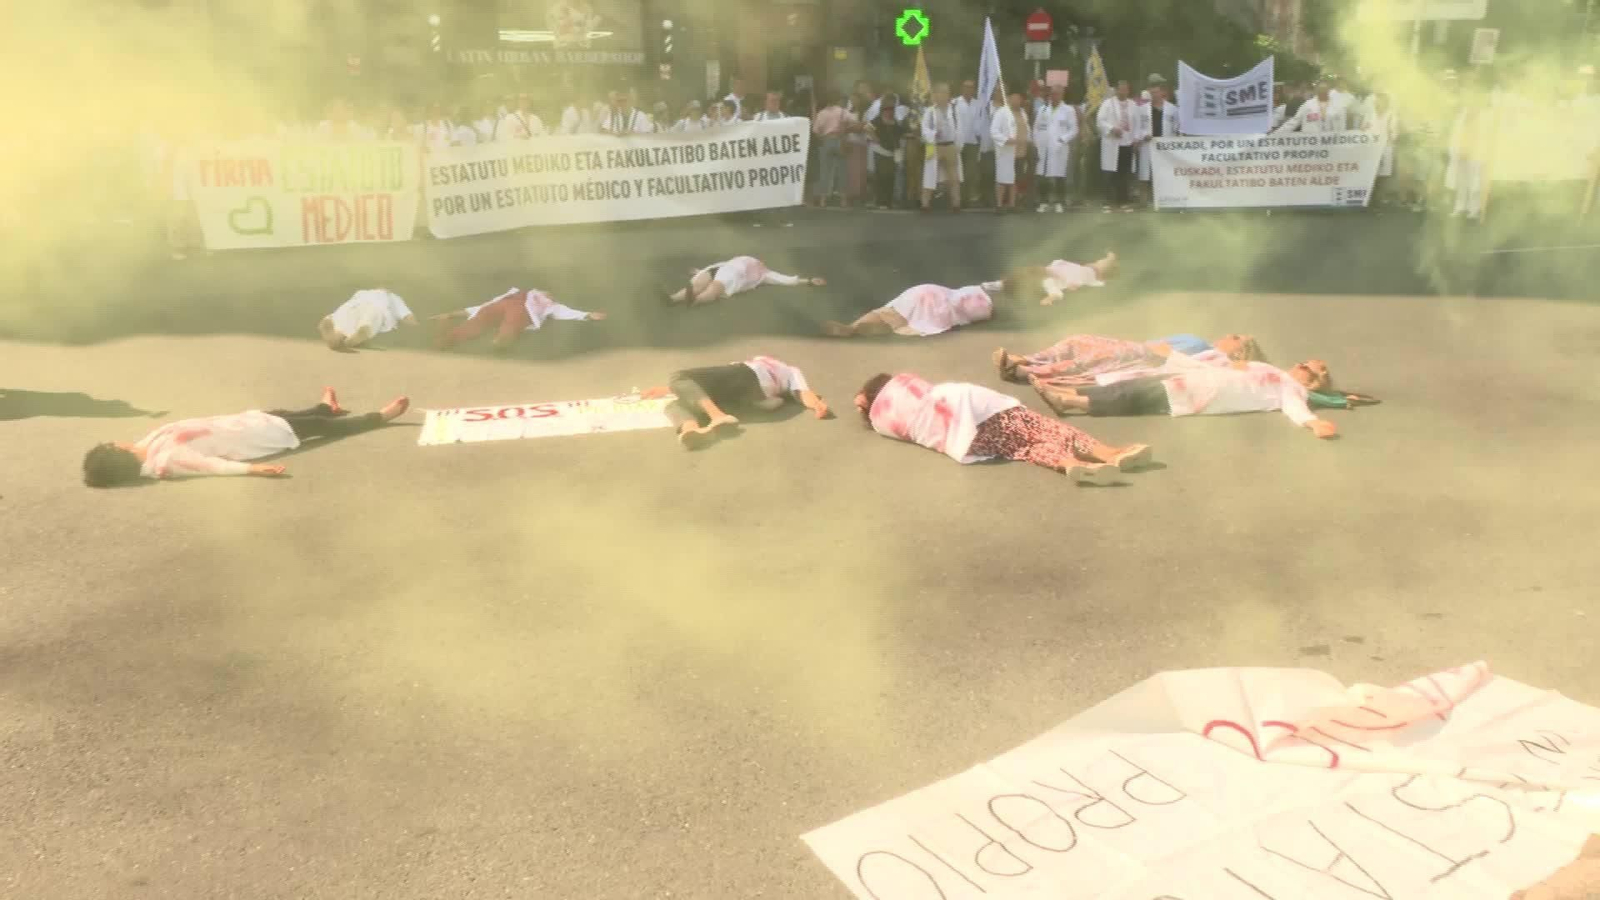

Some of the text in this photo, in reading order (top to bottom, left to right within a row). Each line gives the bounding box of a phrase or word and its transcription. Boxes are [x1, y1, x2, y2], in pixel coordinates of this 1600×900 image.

[1225, 81, 1267, 106] SME
[1210, 140, 1234, 149] POR
[1236, 139, 1255, 148] UN
[1258, 136, 1318, 148] ESTATUTO
[430, 133, 801, 186] ESTATUTU MEDIKO ETA FAKULTATIBO BATEN ALDE
[1201, 149, 1329, 162] FACULTATIVO PROPIO
[1226, 164, 1282, 175] ESTATUTU
[1286, 162, 1335, 173] MEDIKO
[1337, 162, 1360, 172] ETA
[1188, 176, 1340, 189] FAKULTATIBO BATEN ALDE
[432, 195, 467, 217] POR
[469, 191, 493, 213] UN
[495, 183, 569, 209] ESTATUTO
[572, 178, 631, 201] MÉDICO
[634, 179, 644, 198] Y
[649, 170, 745, 197] FACULTATIVO
[301, 193, 394, 244] MEDICO
